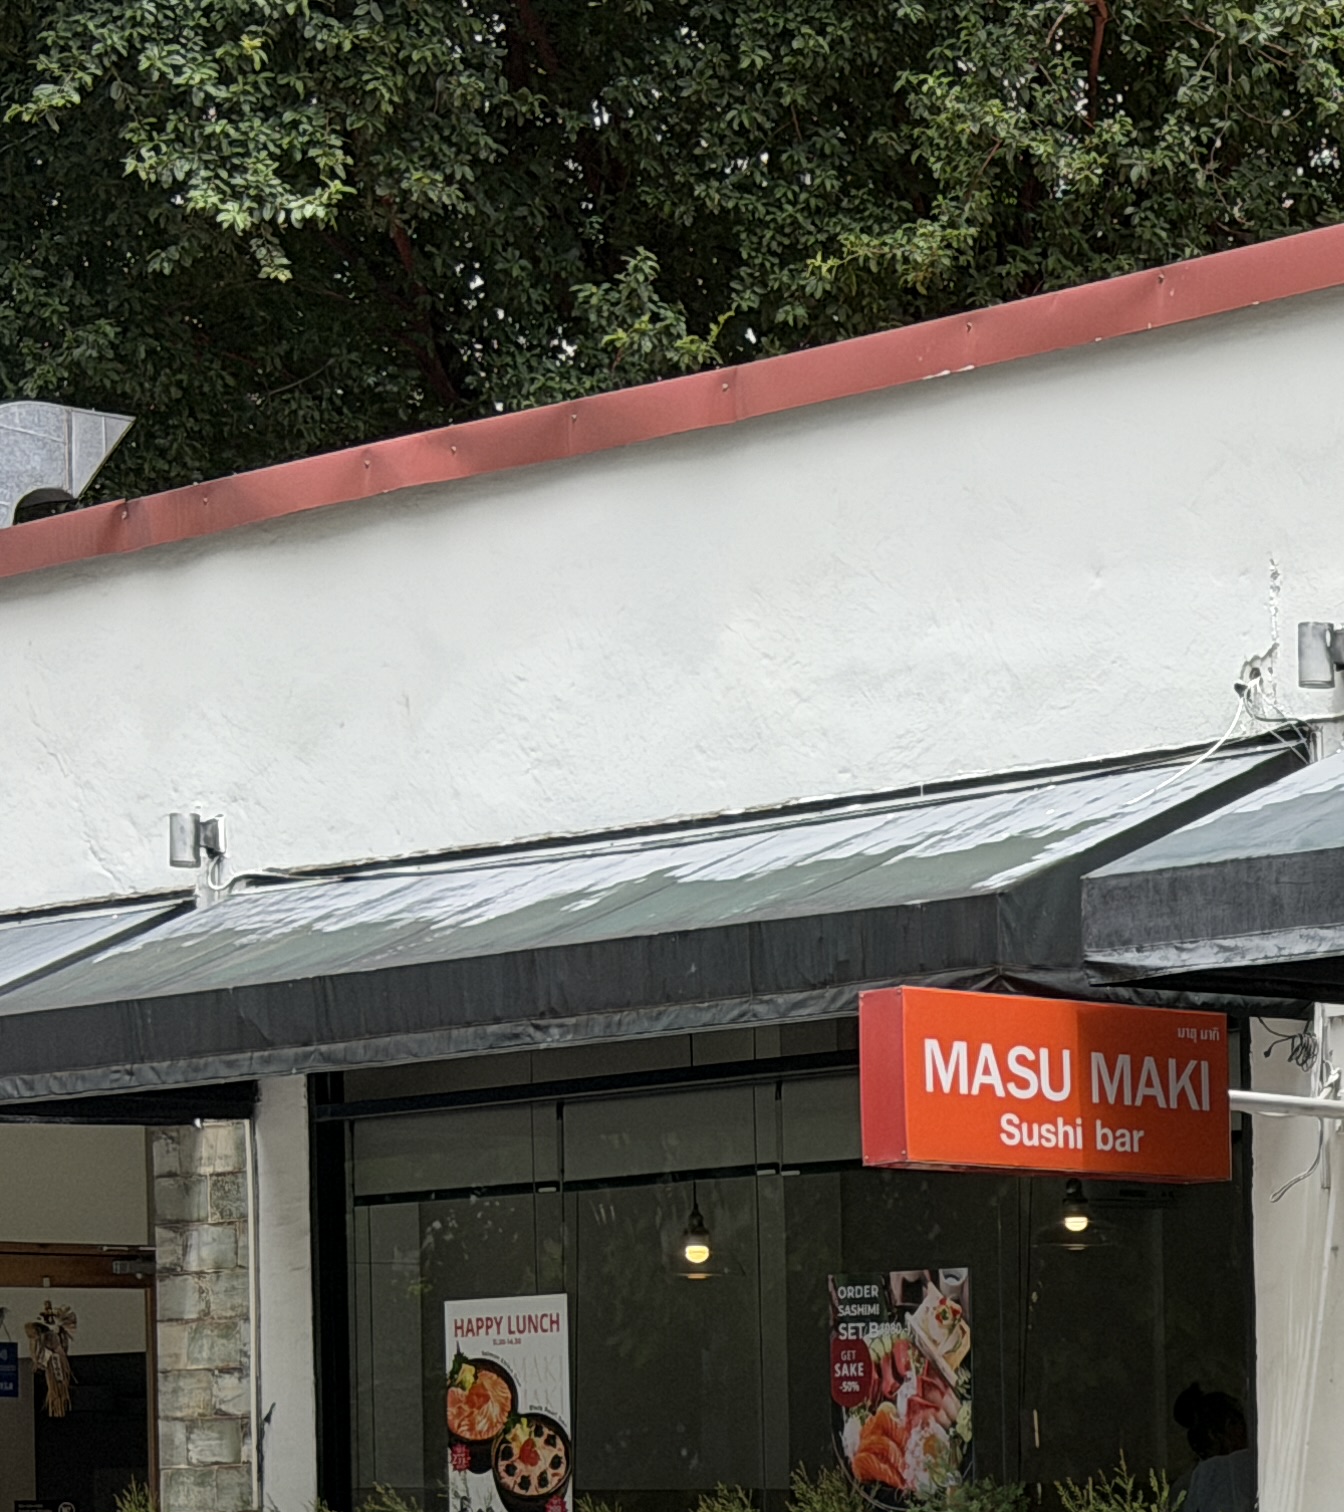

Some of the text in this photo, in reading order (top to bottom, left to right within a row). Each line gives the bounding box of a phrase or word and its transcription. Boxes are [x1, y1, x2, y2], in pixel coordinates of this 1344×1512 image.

[924, 1038, 1211, 1112] MASU MAKI
[1000, 1112, 1145, 1153] Sushi bar
[837, 1284, 879, 1300] ORDER
[837, 1303, 880, 1317] SASHIMI
[453, 1312, 561, 1338] HAPPY LUNCH
[838, 1322, 865, 1340] SET
[840, 1349, 857, 1362] GET
[834, 1362, 865, 1378] SAKE
